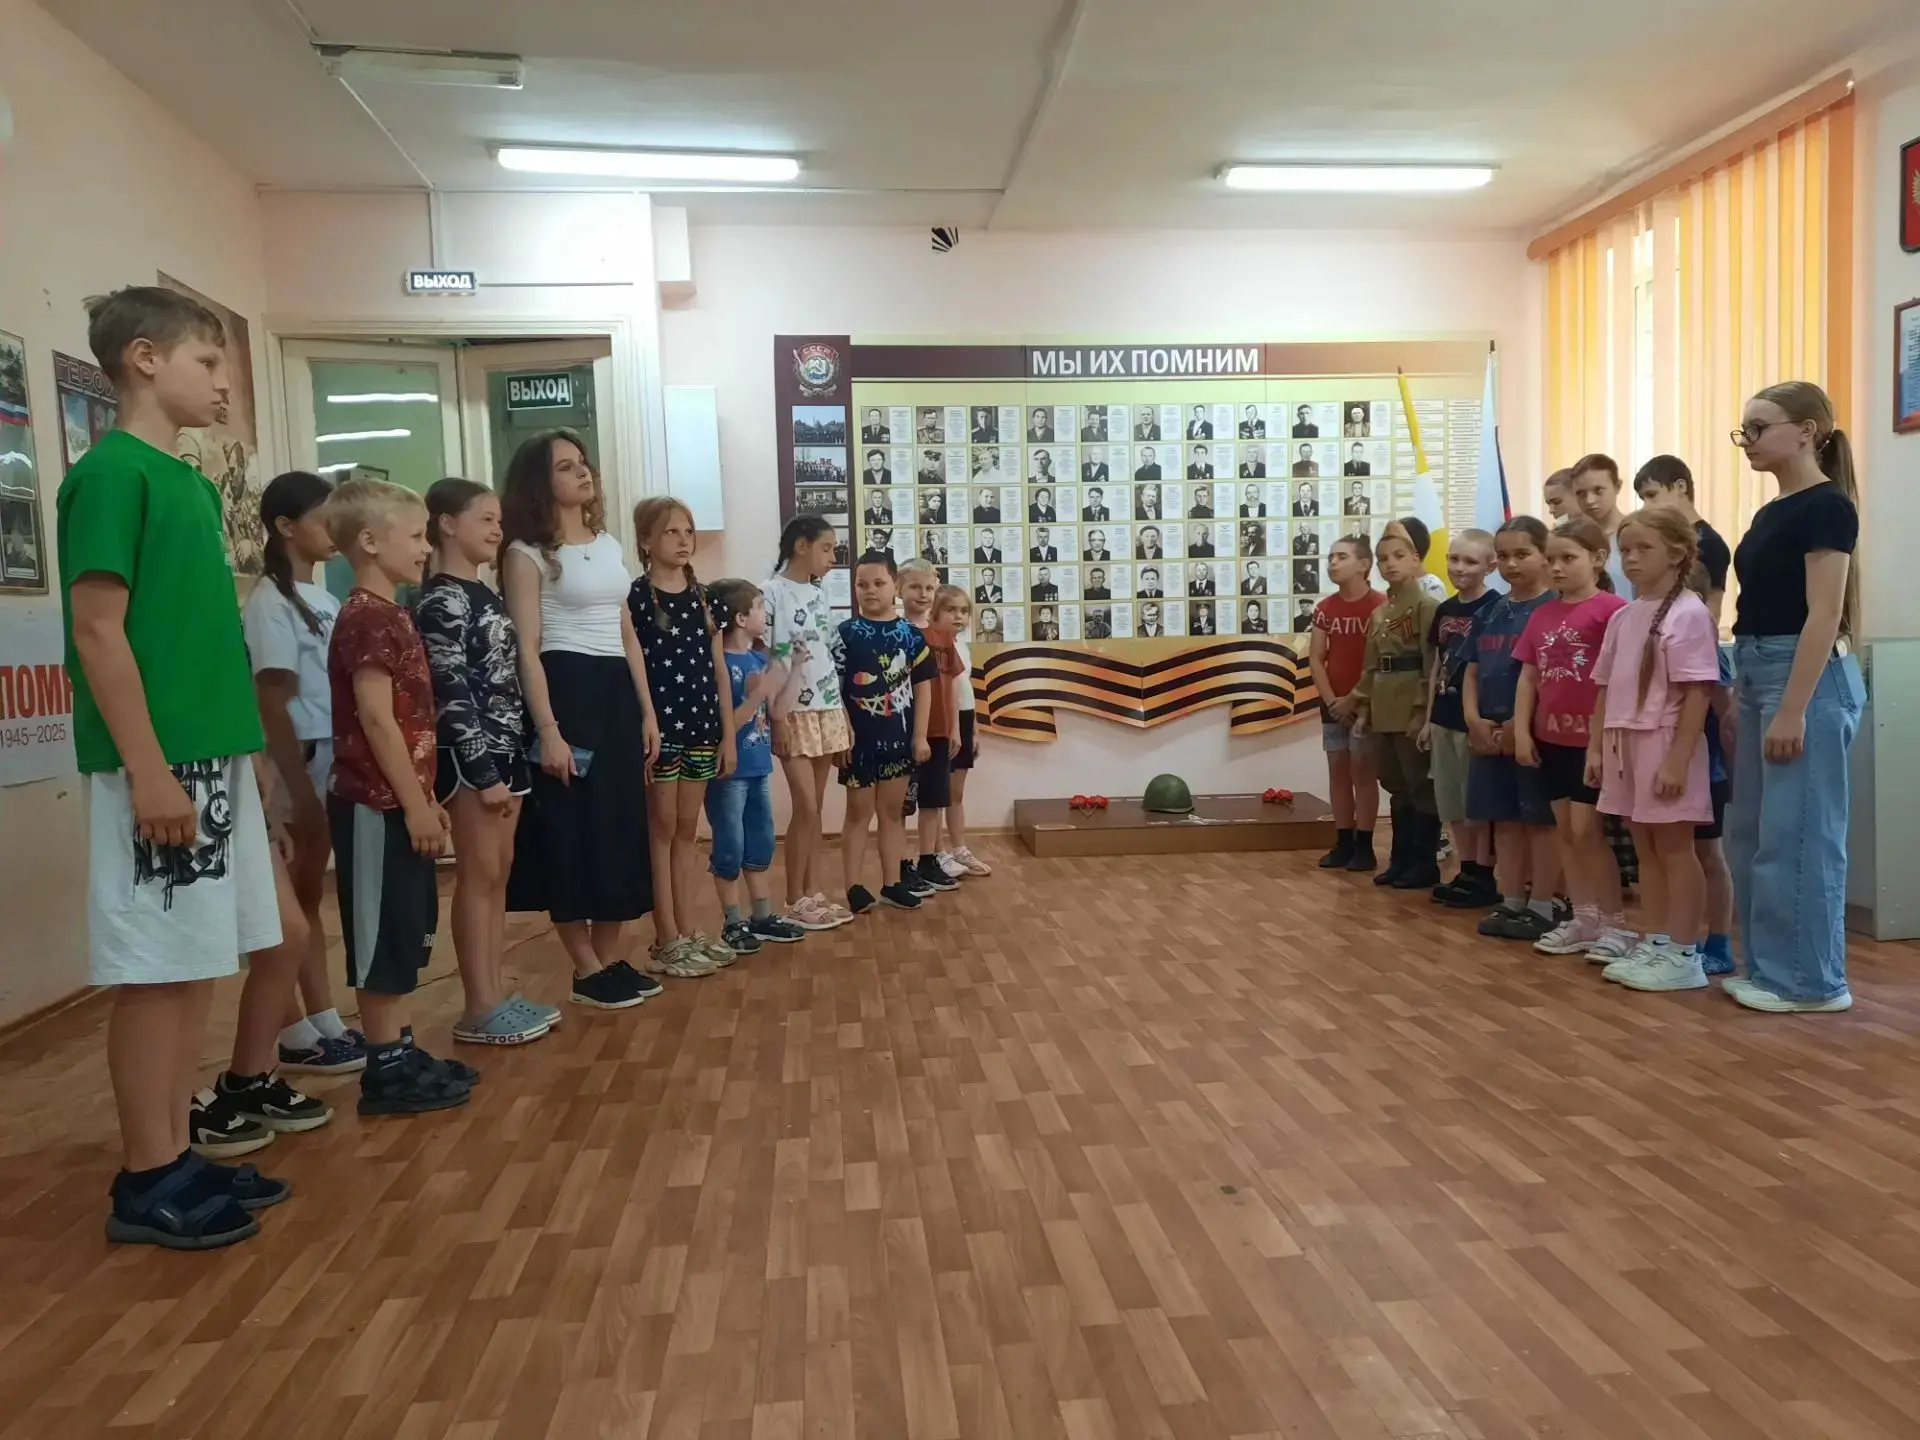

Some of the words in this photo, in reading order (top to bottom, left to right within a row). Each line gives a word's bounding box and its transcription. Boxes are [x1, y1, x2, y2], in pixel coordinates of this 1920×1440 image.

[413, 274, 472, 288] ВЫХОД
[1032, 350, 1082, 375] МЫ
[1089, 350, 1126, 374] ИХ
[1131, 348, 1259, 374] ПОМНИМ
[510, 377, 570, 402] ВЫХОД
